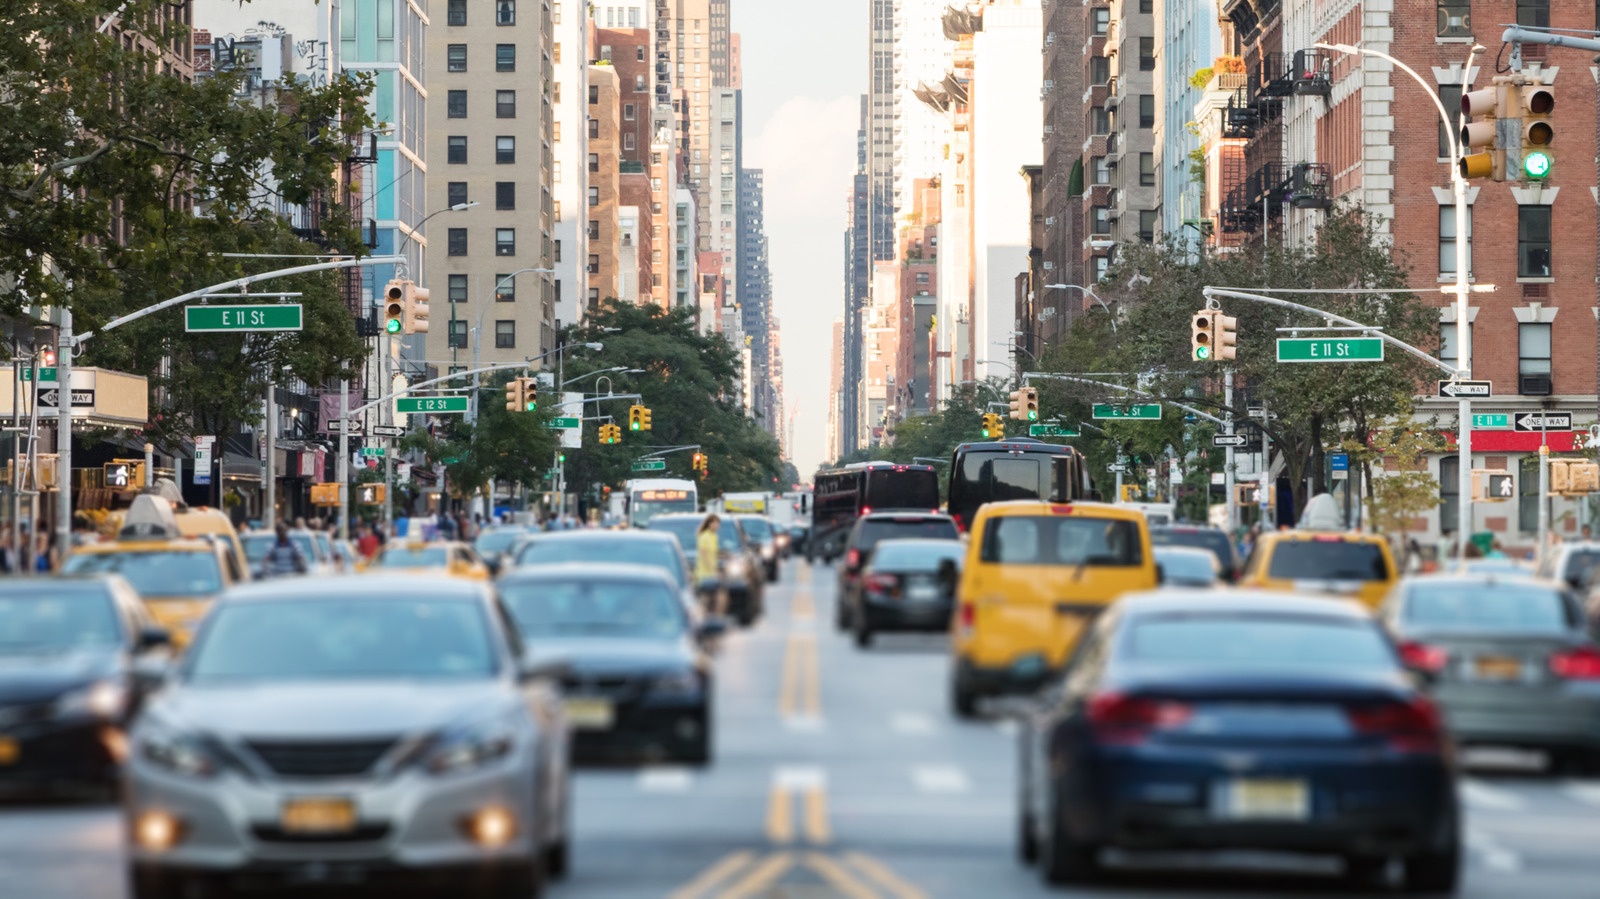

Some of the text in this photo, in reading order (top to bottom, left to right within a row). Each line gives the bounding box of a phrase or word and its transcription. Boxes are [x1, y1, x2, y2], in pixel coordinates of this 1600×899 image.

[222, 310, 265, 325] E 11 St
[1310, 343, 1349, 356] E 11 St
[23, 369, 30, 380] E
[47, 394, 89, 402] ON WAY
[417, 400, 447, 410] E 12 St
[1132, 407, 1141, 416] St
[1477, 416, 1483, 426] E
[1486, 416, 1493, 425] 11
[1525, 418, 1541, 426] ONE
